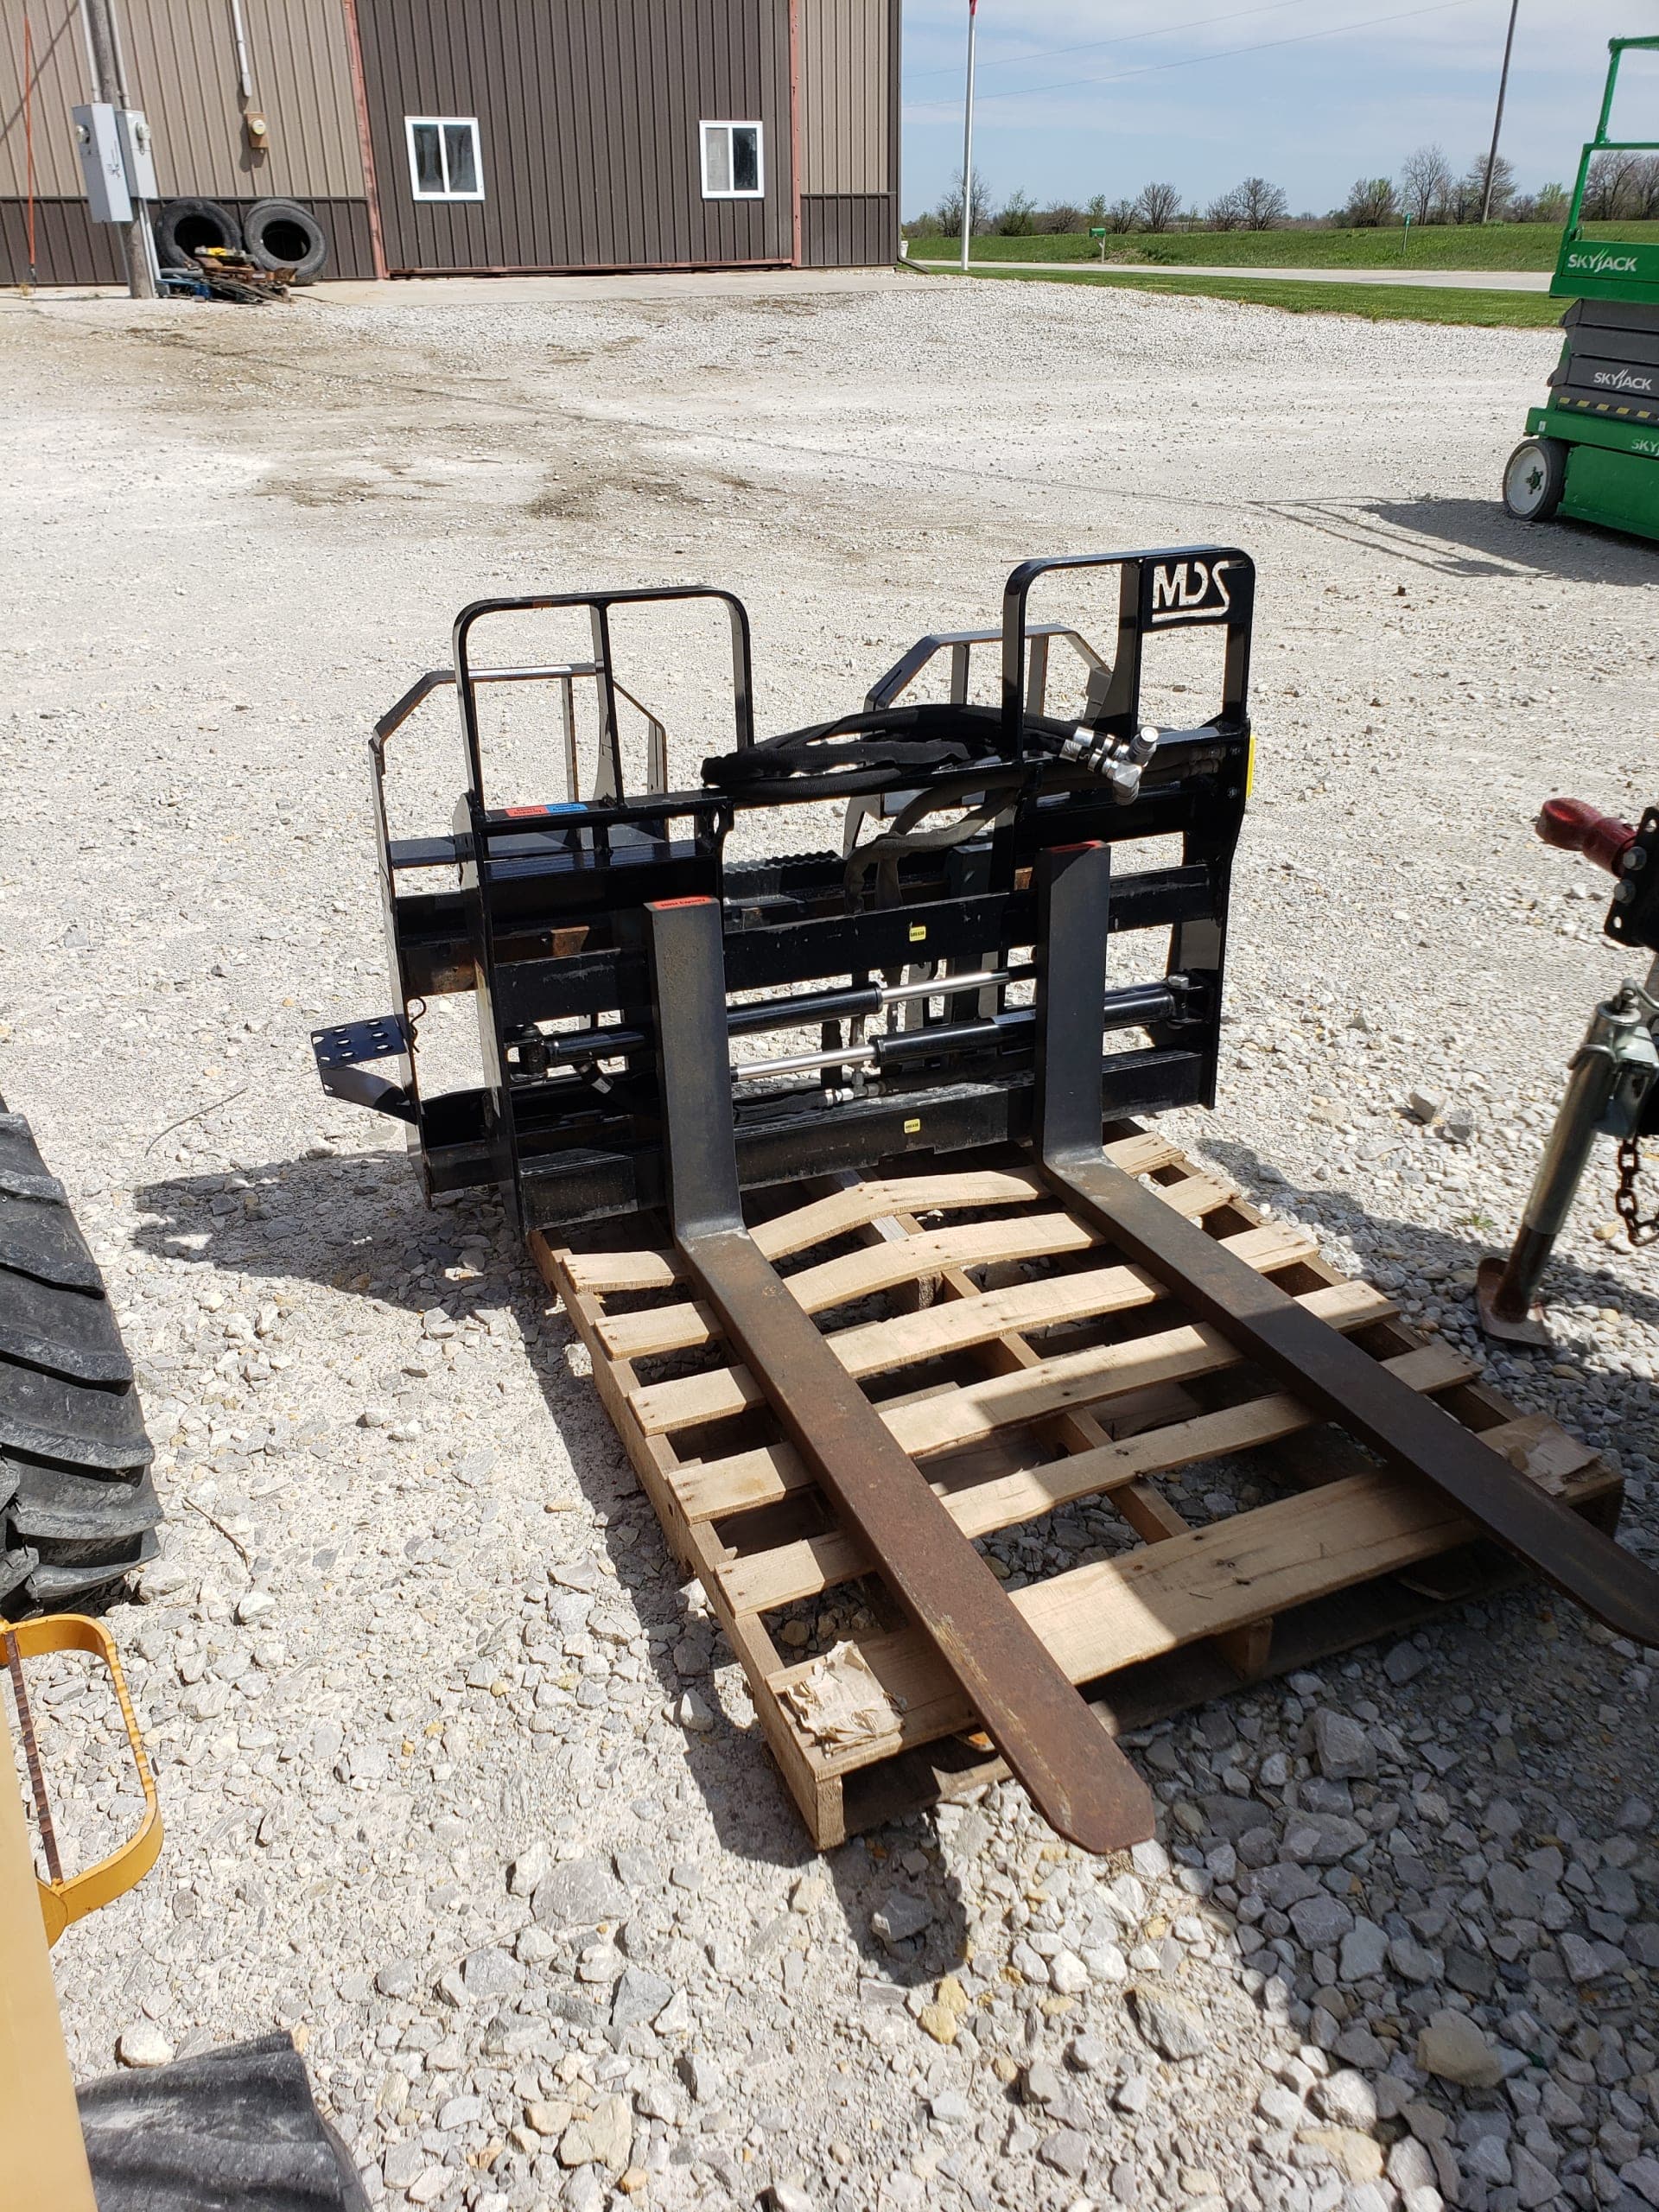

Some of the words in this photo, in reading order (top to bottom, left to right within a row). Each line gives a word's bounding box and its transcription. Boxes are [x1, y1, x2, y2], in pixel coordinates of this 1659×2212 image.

[1567, 248, 1638, 272] SKYJACK
[1593, 368, 1653, 391] SKYJACK
[1152, 560, 1230, 623] MDS
